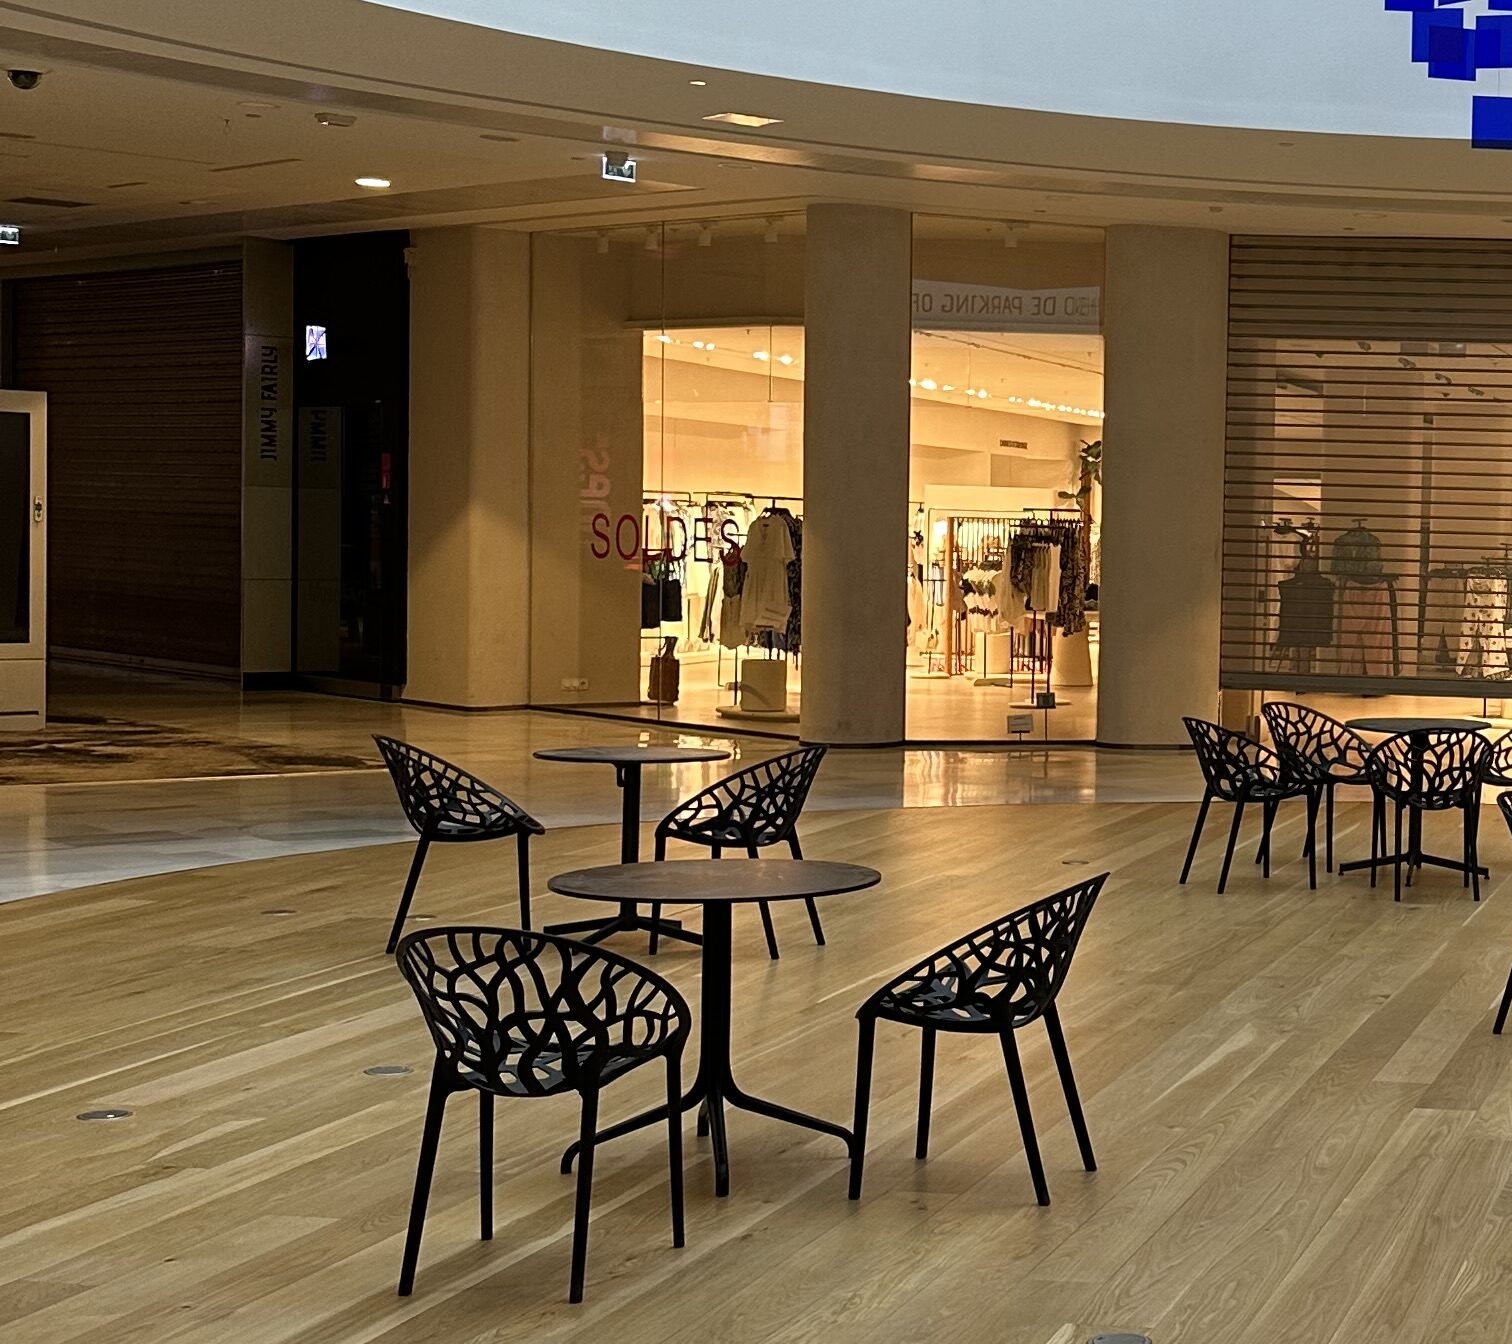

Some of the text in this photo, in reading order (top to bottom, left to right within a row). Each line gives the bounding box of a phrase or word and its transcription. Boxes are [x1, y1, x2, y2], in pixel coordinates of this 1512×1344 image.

[260, 346, 278, 461] JIMMY FAIRLY
[591, 513, 742, 567] SOLDES
